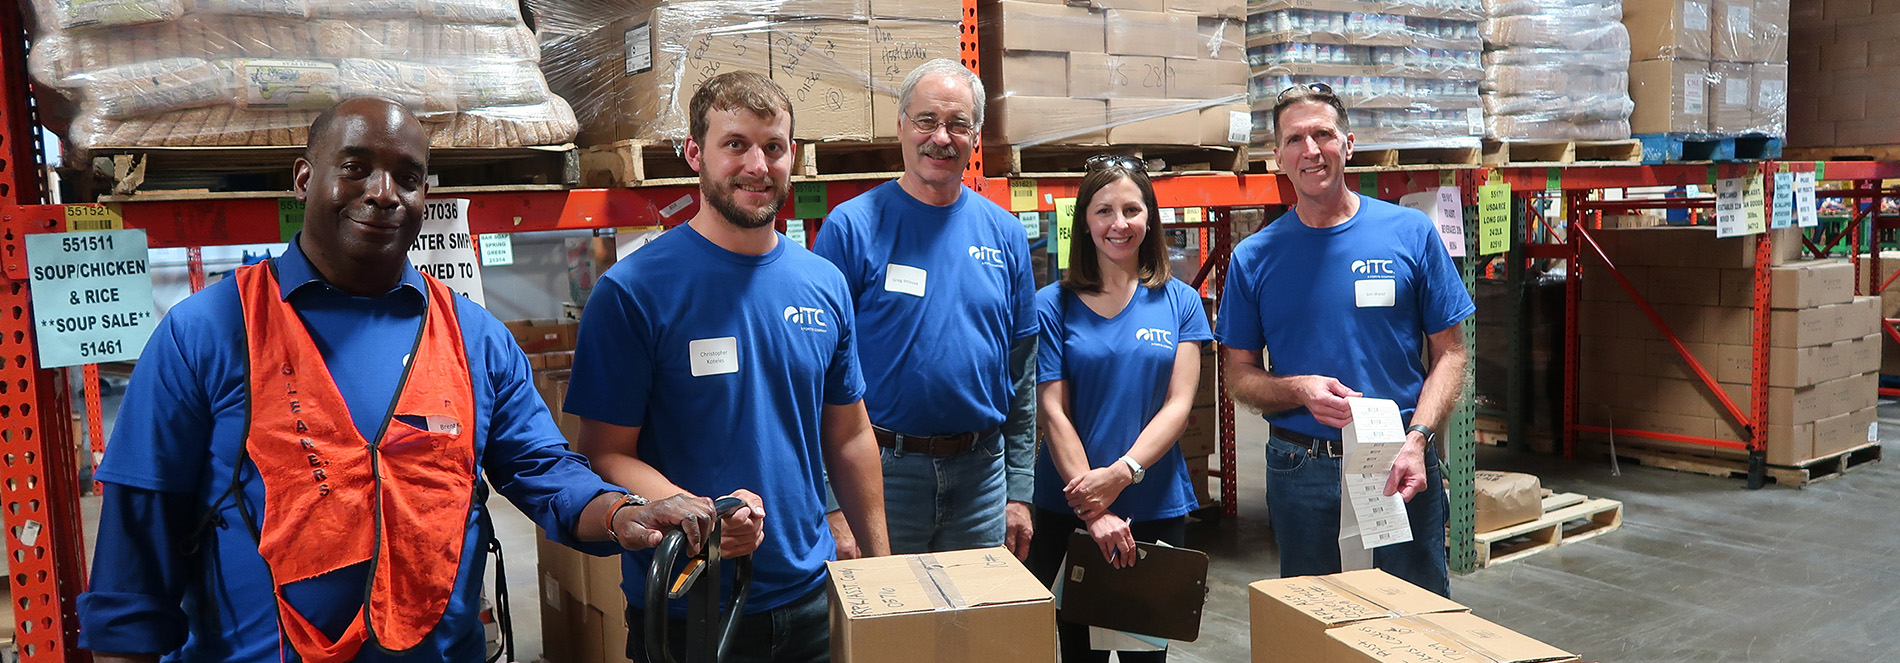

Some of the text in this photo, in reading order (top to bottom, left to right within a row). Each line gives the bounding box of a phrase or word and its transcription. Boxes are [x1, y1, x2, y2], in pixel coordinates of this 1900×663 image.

[67, 206, 111, 217] 551521
[280, 201, 306, 210] 5515
[1065, 204, 1075, 216] US
[1060, 227, 1071, 239] PEA
[62, 235, 114, 252] 551511
[411, 233, 445, 251] ATER
[980, 245, 1004, 264] ITC
[34, 260, 146, 281] SOUP/CHICKEN
[458, 263, 473, 279] TO
[1366, 259, 1396, 274] ITC
[69, 288, 120, 305] & RICE
[800, 306, 827, 327] ITC
[1149, 328, 1173, 345] ITC
[80, 339, 122, 357] 51461
[700, 349, 728, 358] Christopher
